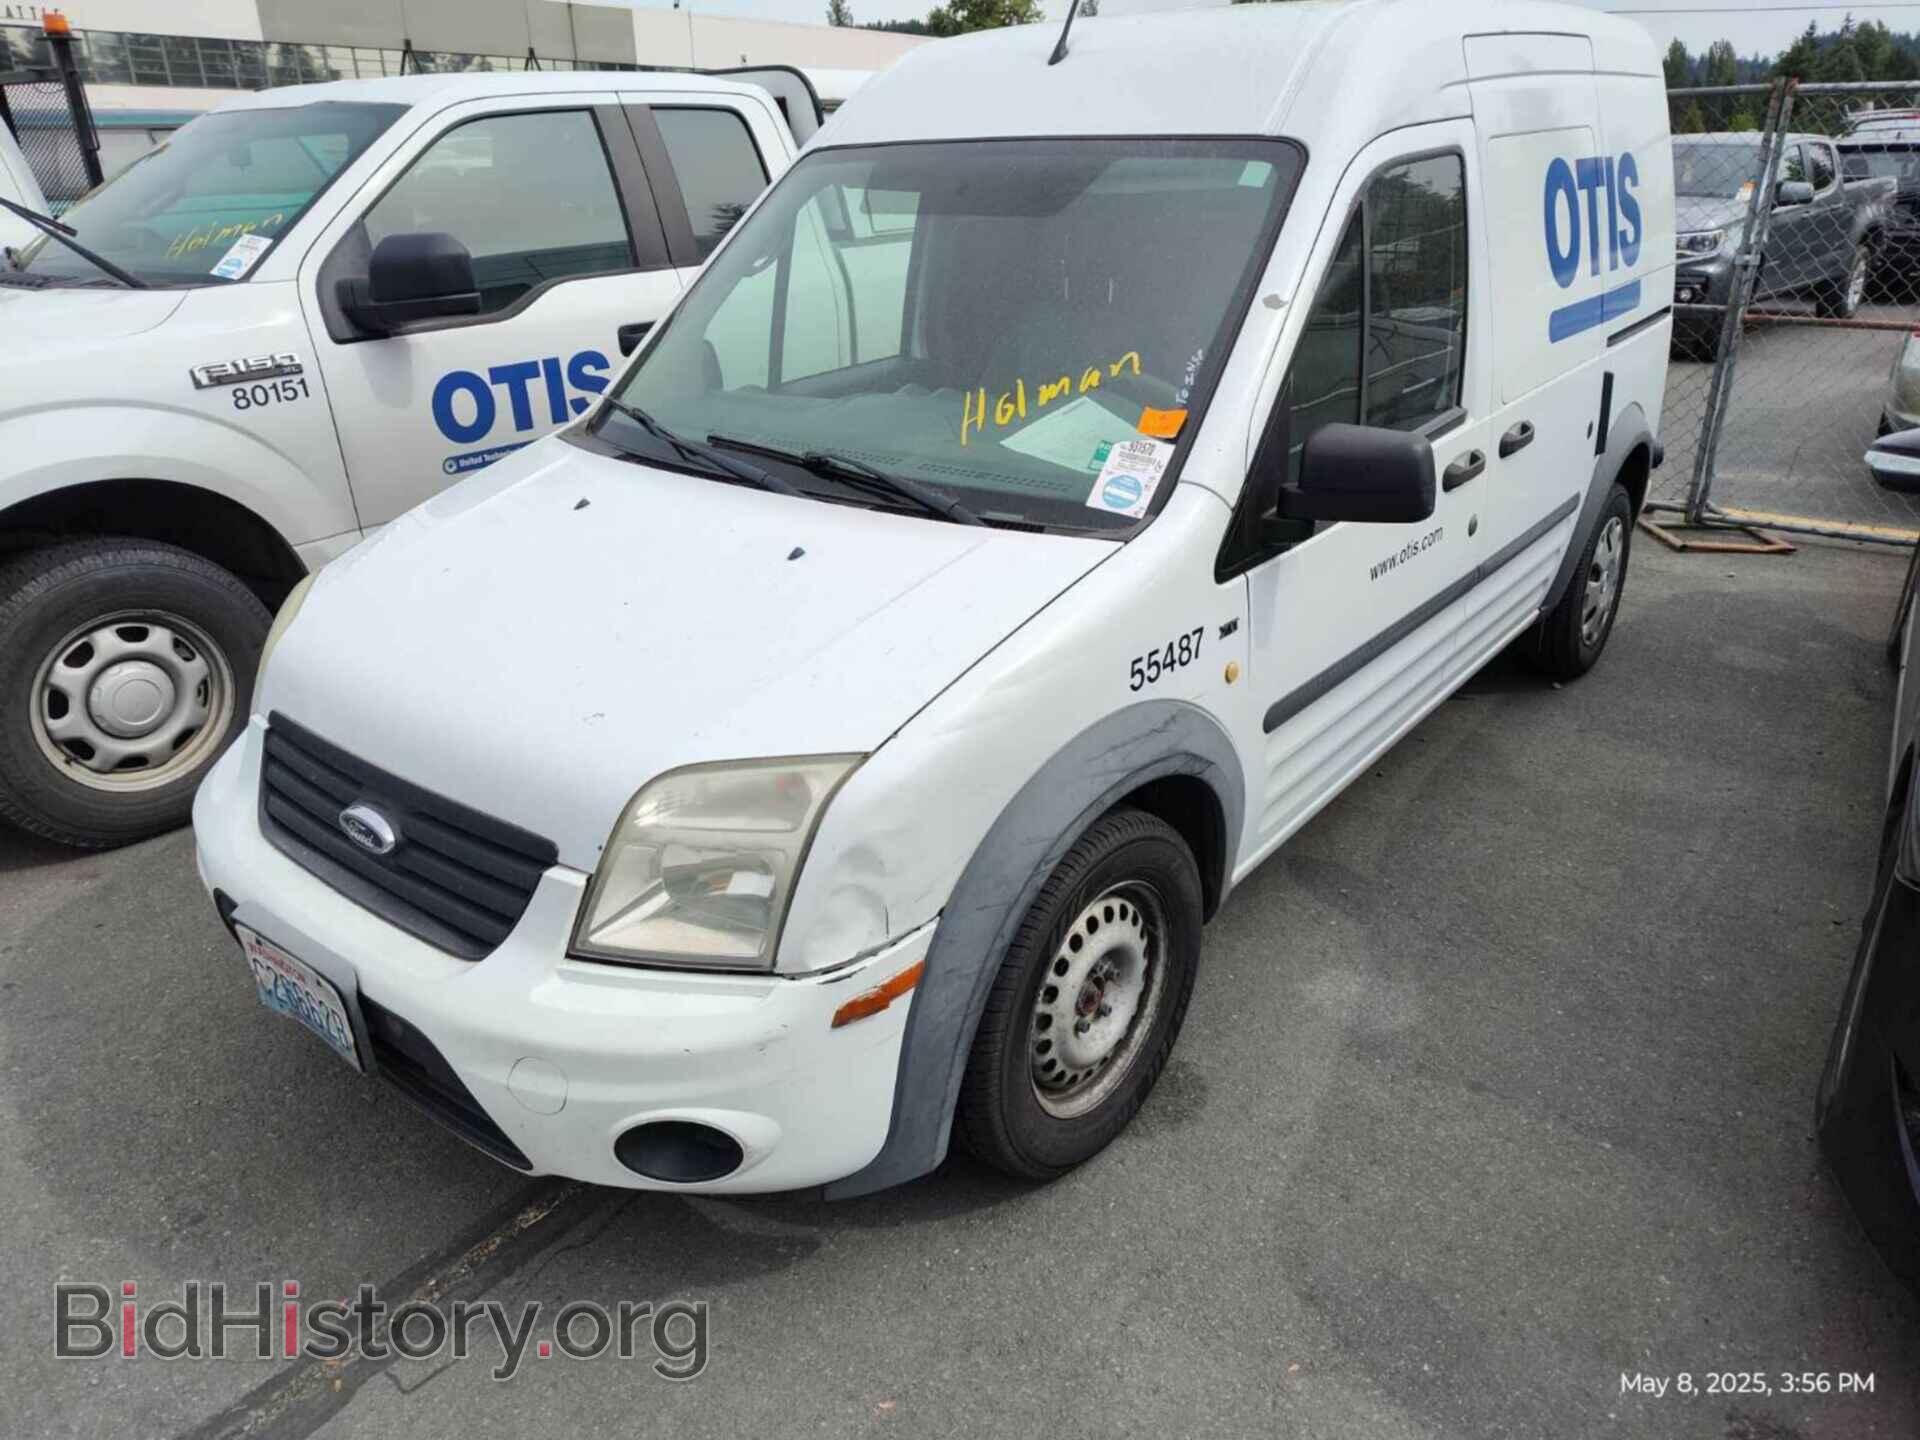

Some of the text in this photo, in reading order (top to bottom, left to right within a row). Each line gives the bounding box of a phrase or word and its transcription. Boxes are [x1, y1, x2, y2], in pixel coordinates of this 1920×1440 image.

[164, 213, 284, 258] Holman
[1544, 152, 1642, 289] OTIS
[232, 377, 310, 410] 80151
[432, 350, 611, 444] OTIS
[961, 351, 1141, 446] Holman
[1370, 527, 1443, 581] www.otis.com
[1130, 626, 1204, 692] 55487
